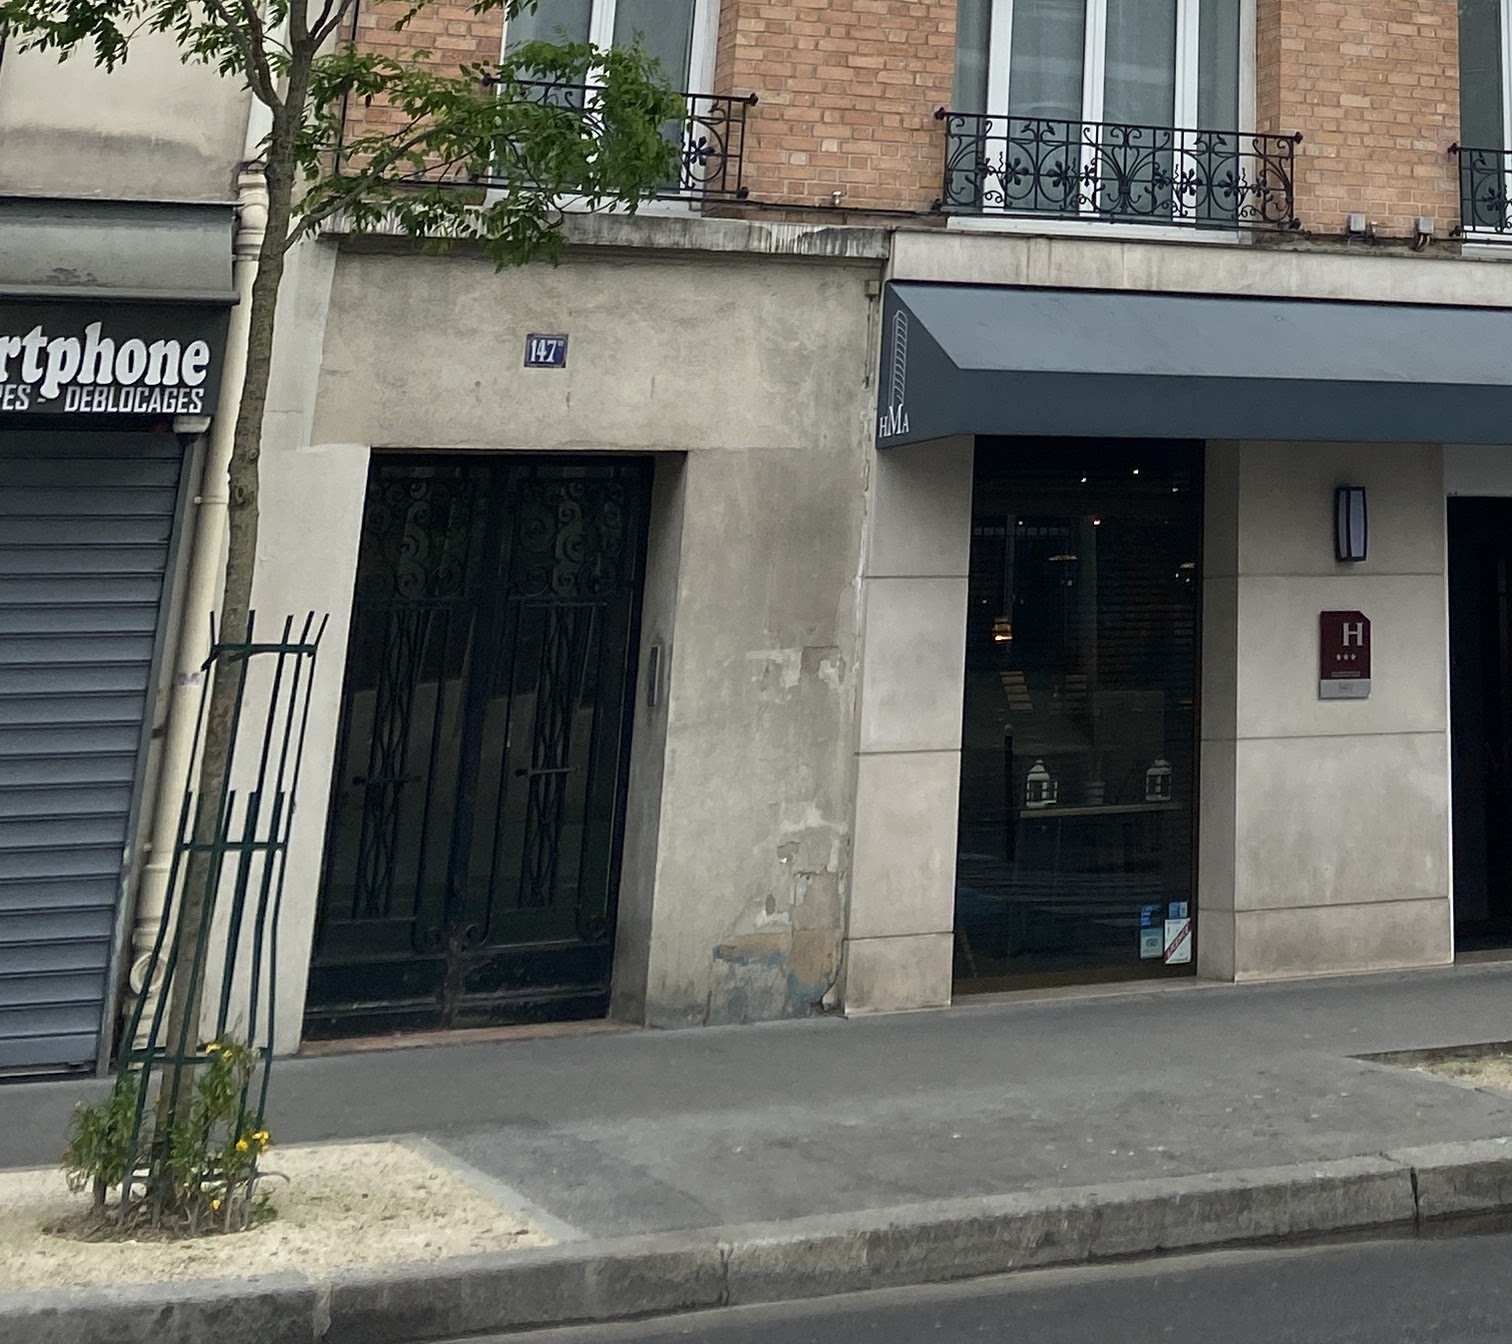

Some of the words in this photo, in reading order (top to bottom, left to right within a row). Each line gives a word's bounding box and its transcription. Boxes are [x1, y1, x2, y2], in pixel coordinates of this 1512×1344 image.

[529, 339, 558, 363] 147
[0, 383, 32, 411] ES
[64, 385, 205, 414] DEBLOCAGES
[878, 403, 910, 438] HMA
[1342, 622, 1364, 647] H
